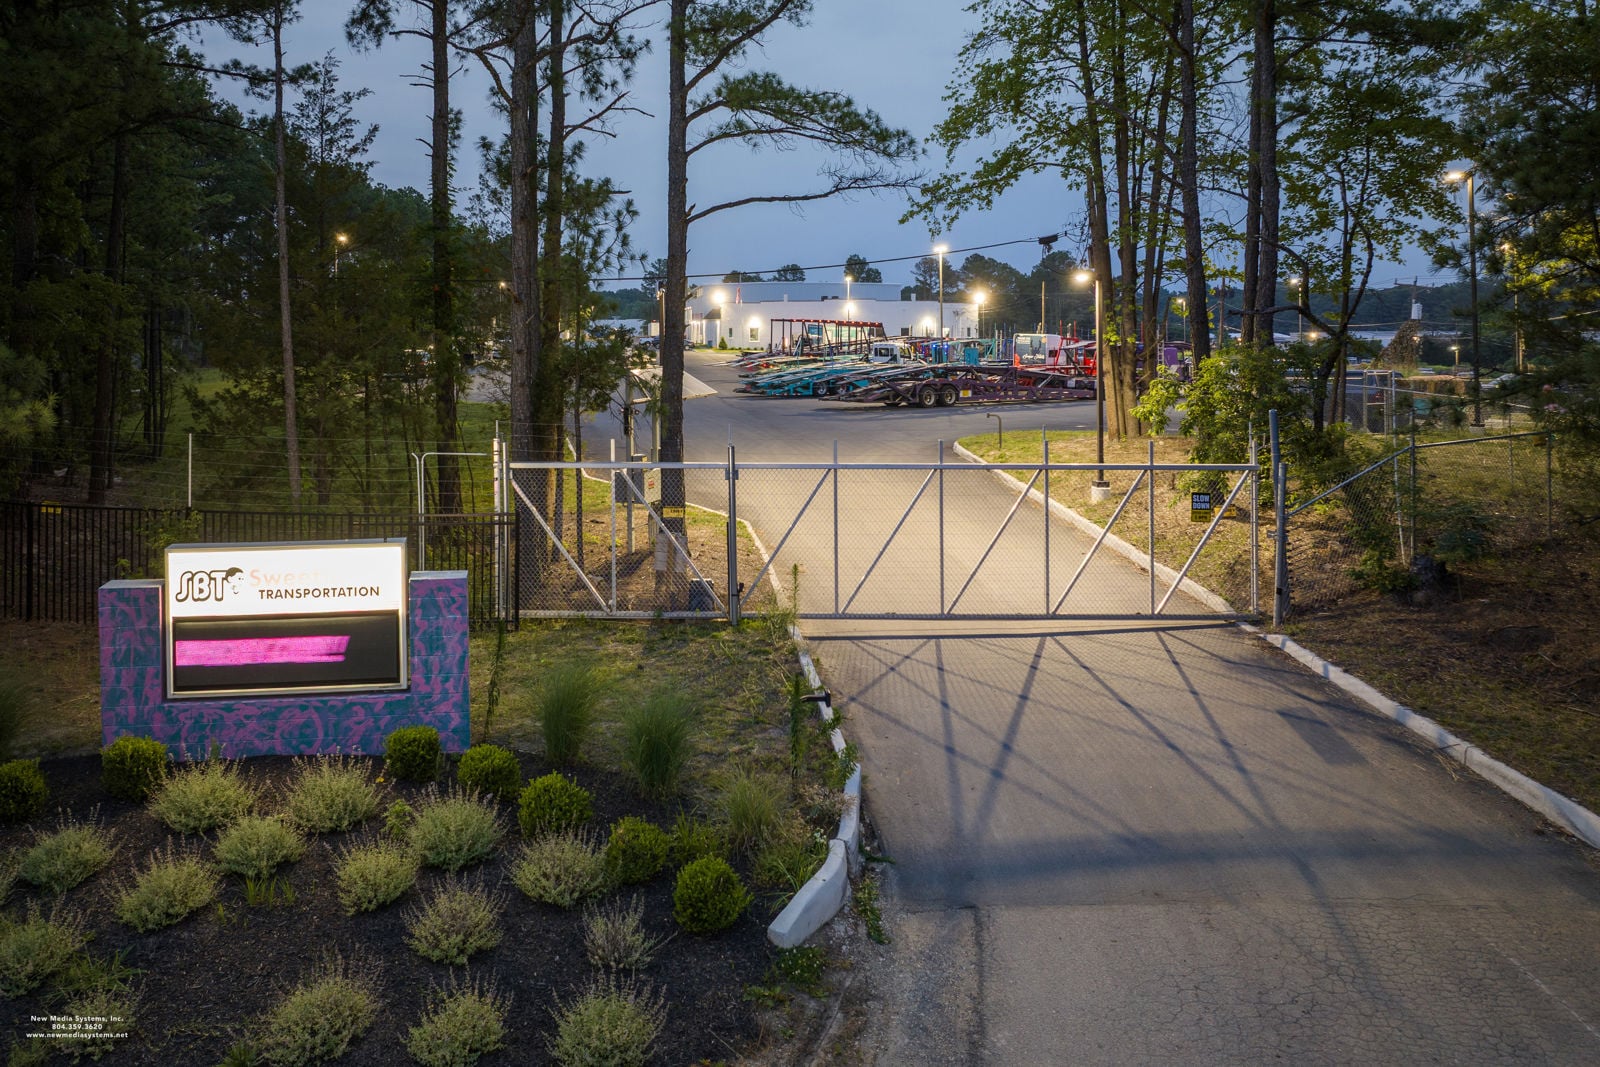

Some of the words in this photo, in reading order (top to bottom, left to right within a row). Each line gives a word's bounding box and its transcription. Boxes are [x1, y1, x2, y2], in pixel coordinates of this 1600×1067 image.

[1192, 494, 1210, 502] SLOW
[1192, 502, 1210, 510] DOWN
[175, 570, 227, 603] SBT
[258, 586, 380, 600] TRANSPORTATION
